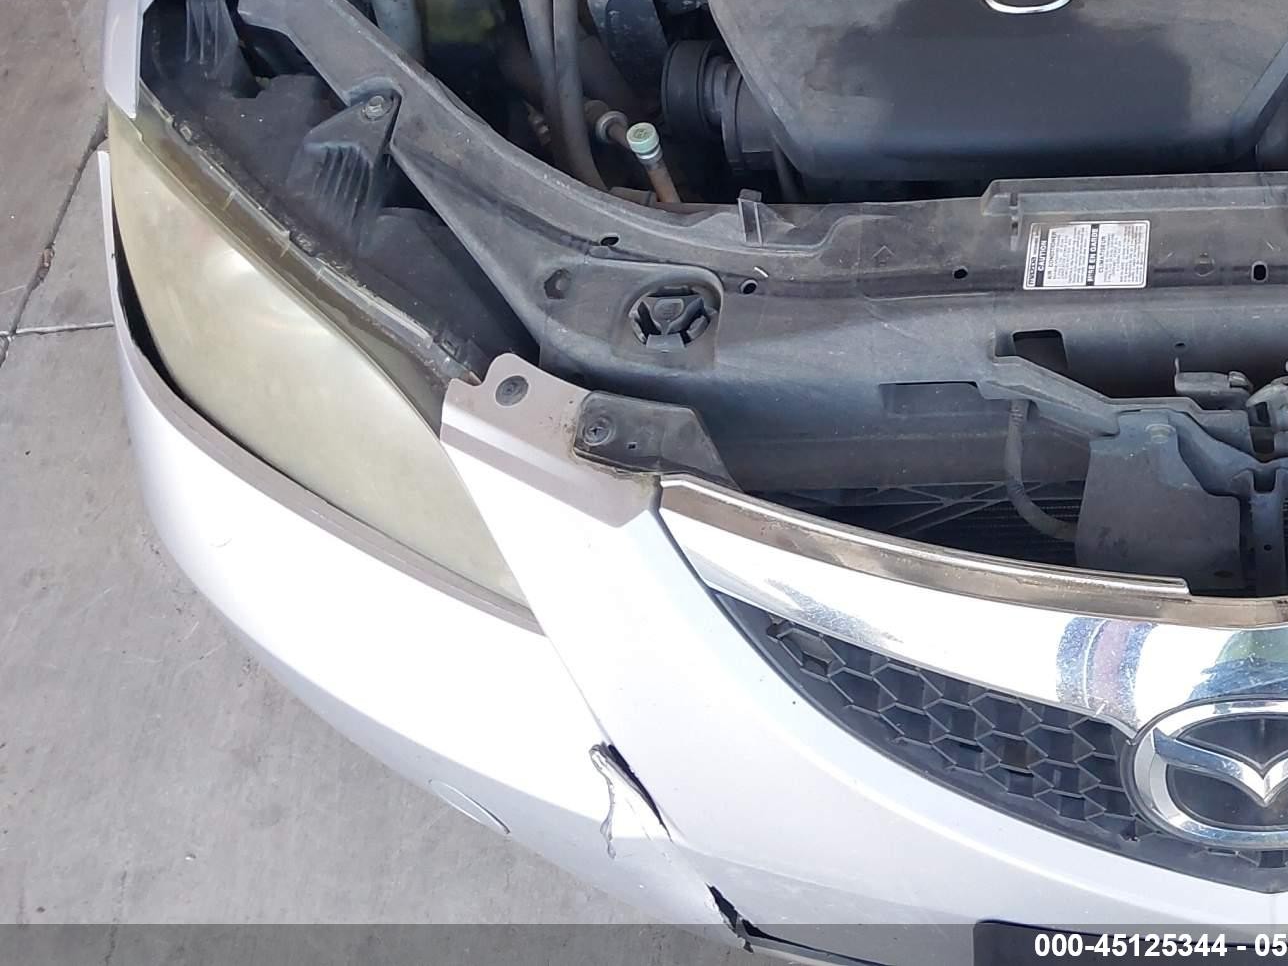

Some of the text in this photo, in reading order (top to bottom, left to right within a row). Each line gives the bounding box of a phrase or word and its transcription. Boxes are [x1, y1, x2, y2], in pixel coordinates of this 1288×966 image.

[1038, 240, 1047, 272] CAUTION
[1087, 228, 1099, 282] MISE EN GARDE
